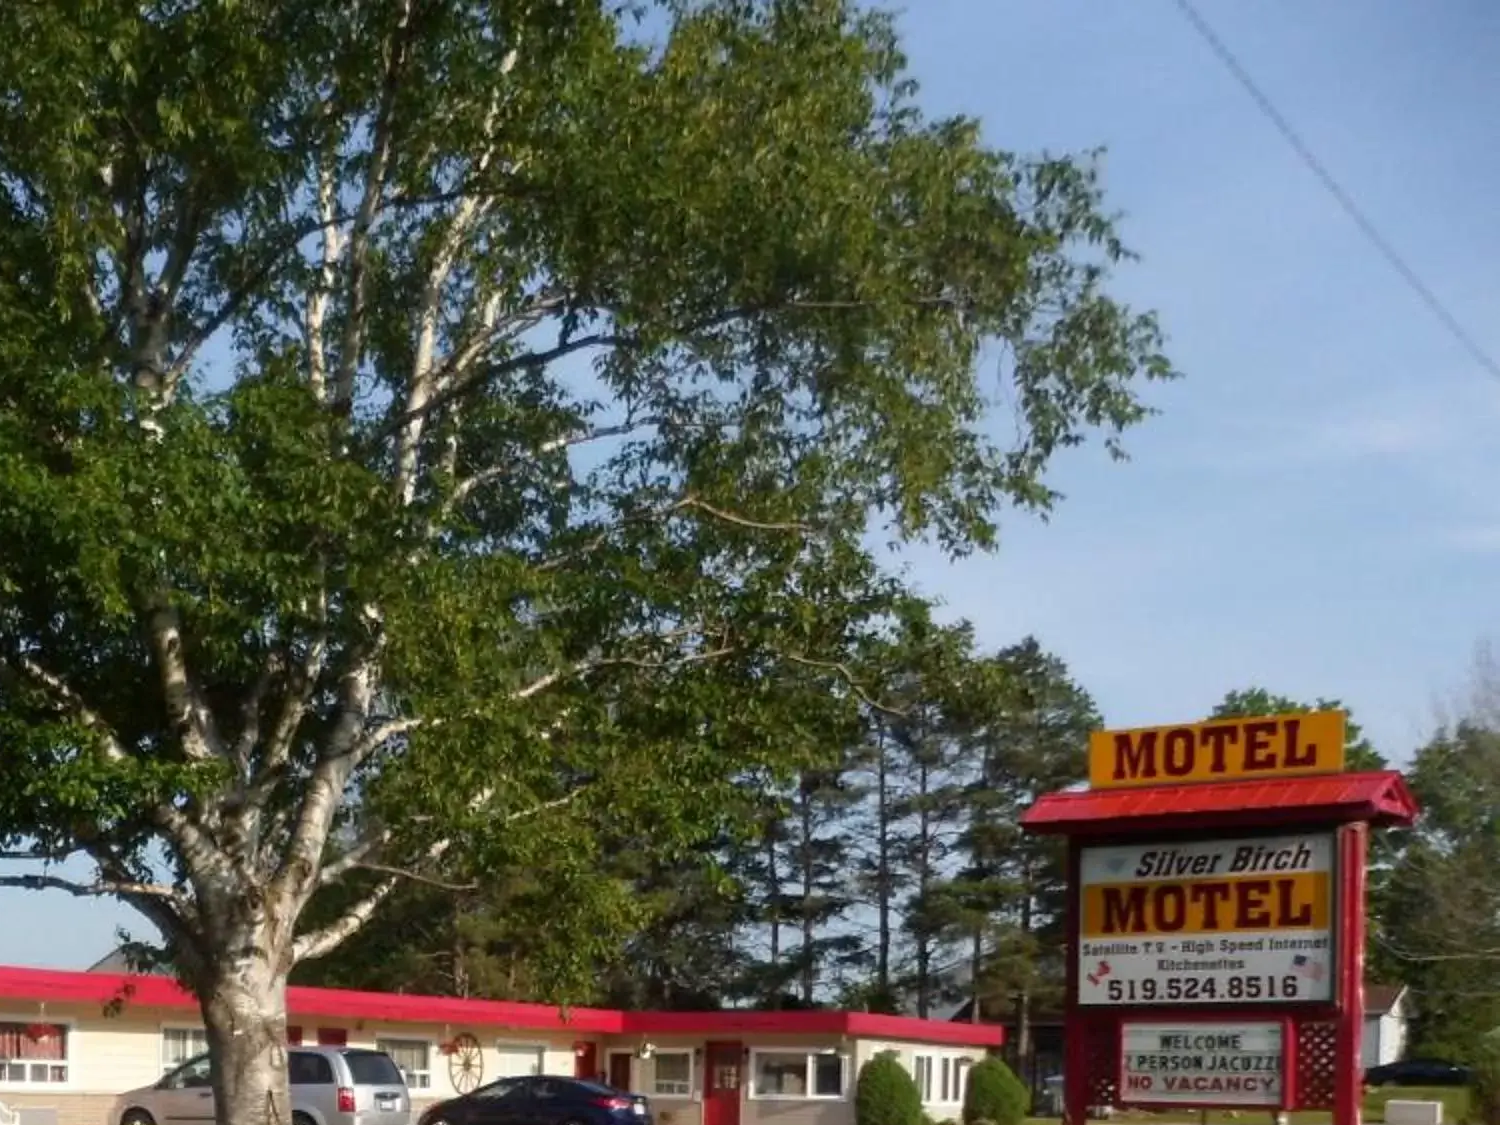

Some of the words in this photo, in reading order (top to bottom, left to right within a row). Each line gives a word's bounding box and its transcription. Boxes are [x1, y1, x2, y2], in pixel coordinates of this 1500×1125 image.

[1113, 719, 1317, 780] MOTEL
[1136, 851, 1220, 877] Silver
[1230, 843, 1311, 872] Birch
[1102, 879, 1311, 934] MOTEL
[1082, 943, 1138, 956] Satellite
[1181, 940, 1215, 954] High
[1220, 939, 1263, 953] Speed
[1269, 937, 1328, 950] Internet
[1157, 958, 1245, 971] Kitchenettes
[1108, 976, 1298, 1000] 519.524.8516
[1160, 1035, 1241, 1050] WELCOME
[1137, 1056, 1202, 1070] PERSON
[1127, 1076, 1153, 1091] NO
[1163, 1076, 1275, 1091] VACANCY
